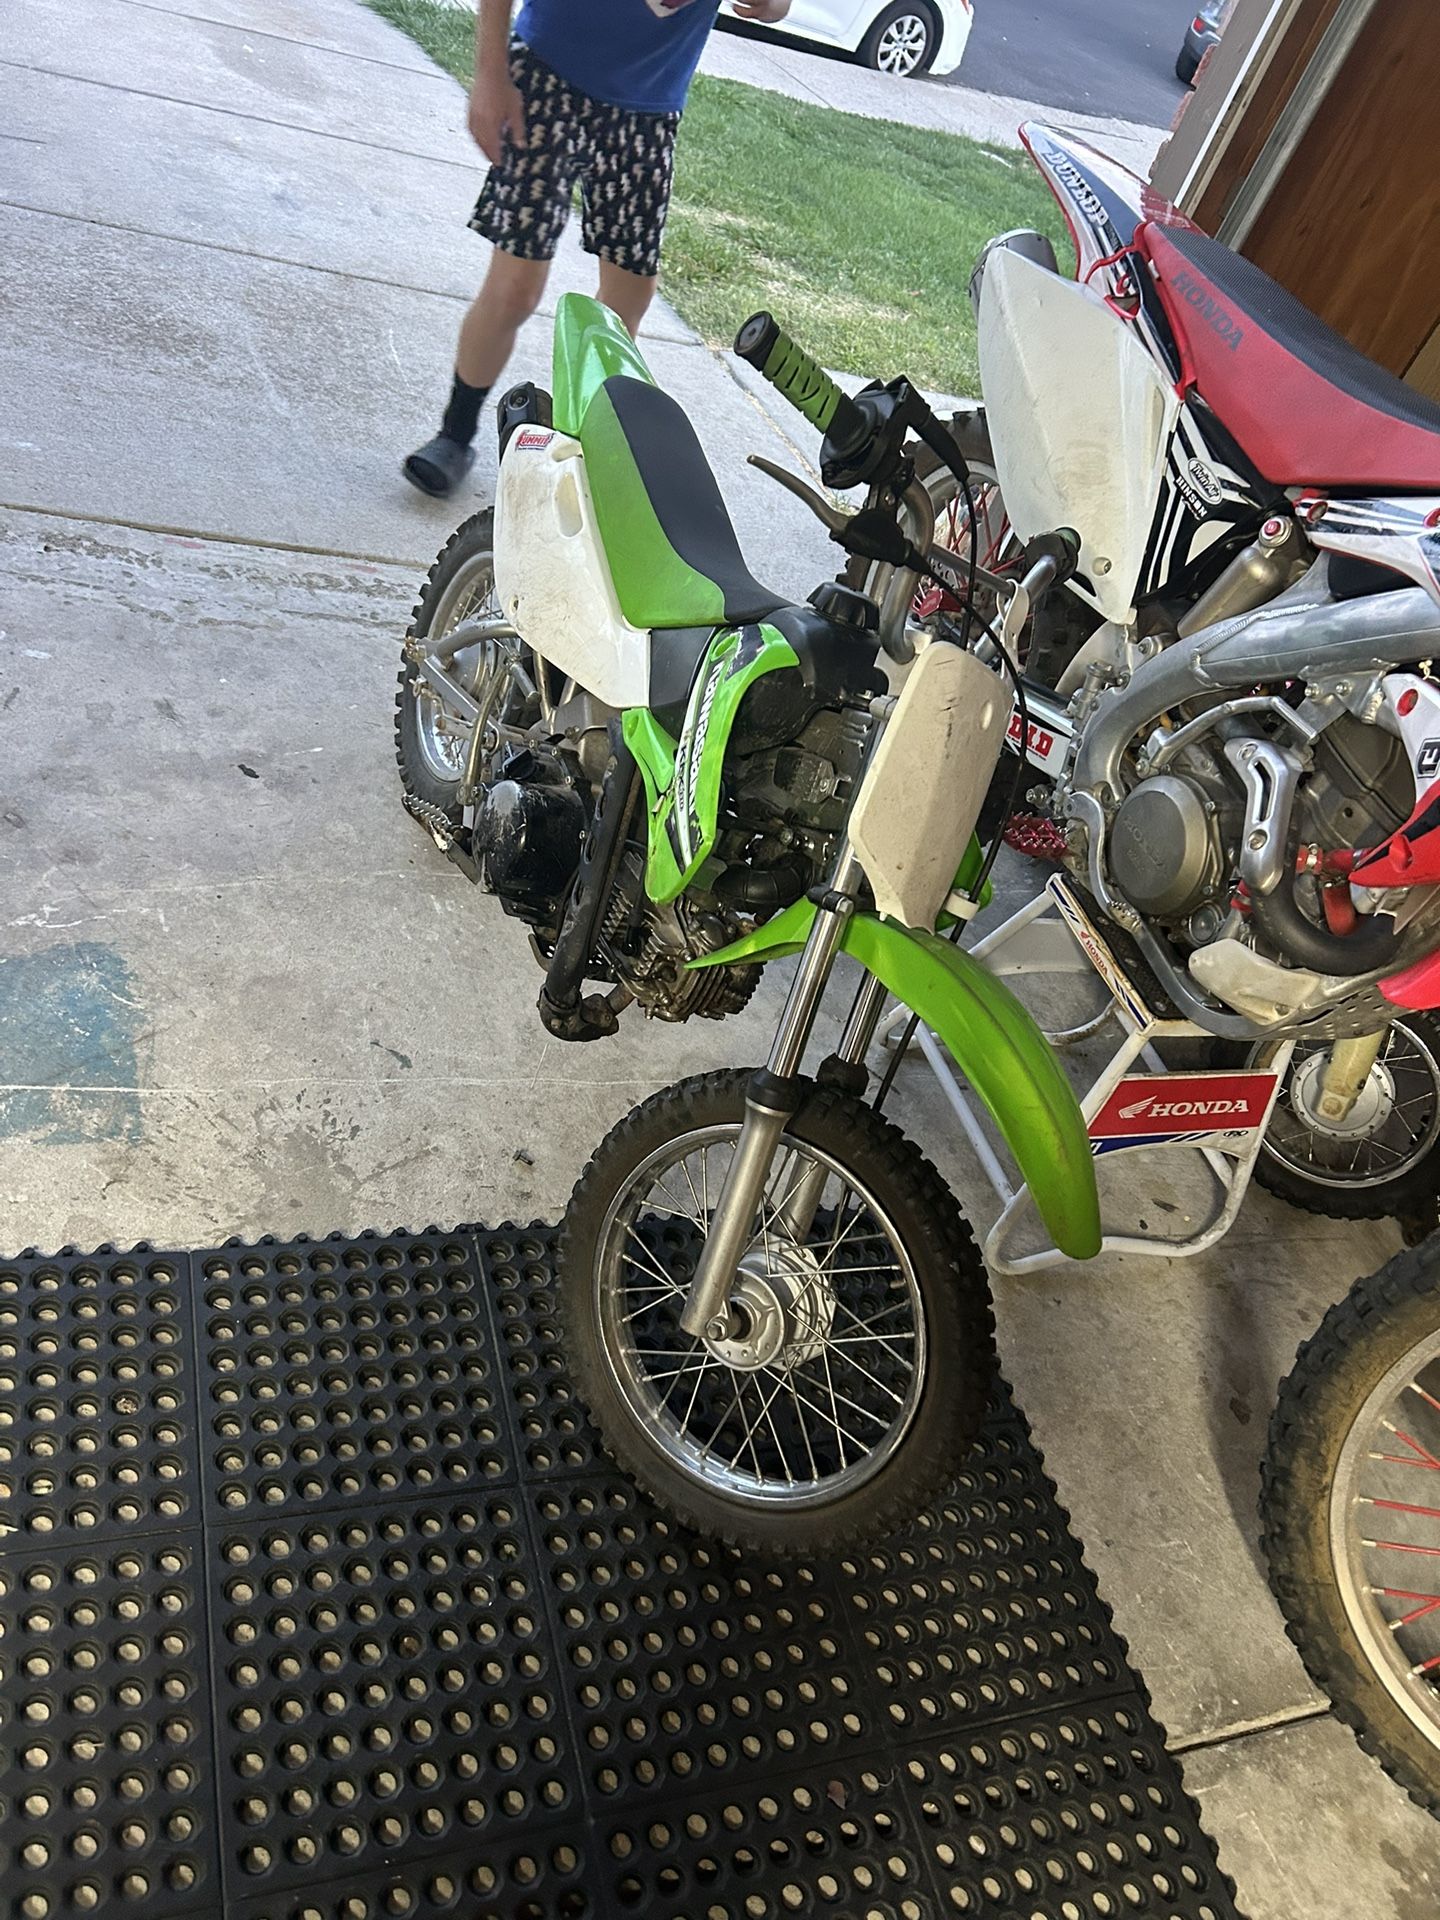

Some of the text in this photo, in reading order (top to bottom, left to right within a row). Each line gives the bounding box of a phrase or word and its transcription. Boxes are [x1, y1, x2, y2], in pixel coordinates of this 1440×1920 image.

[1171, 271, 1244, 352] HONDA
[1175, 475, 1208, 518] HINSON
[1007, 713, 1054, 757] DI.D
[1086, 940, 1108, 976] HONDA
[1147, 1100, 1249, 1118] HONDA
